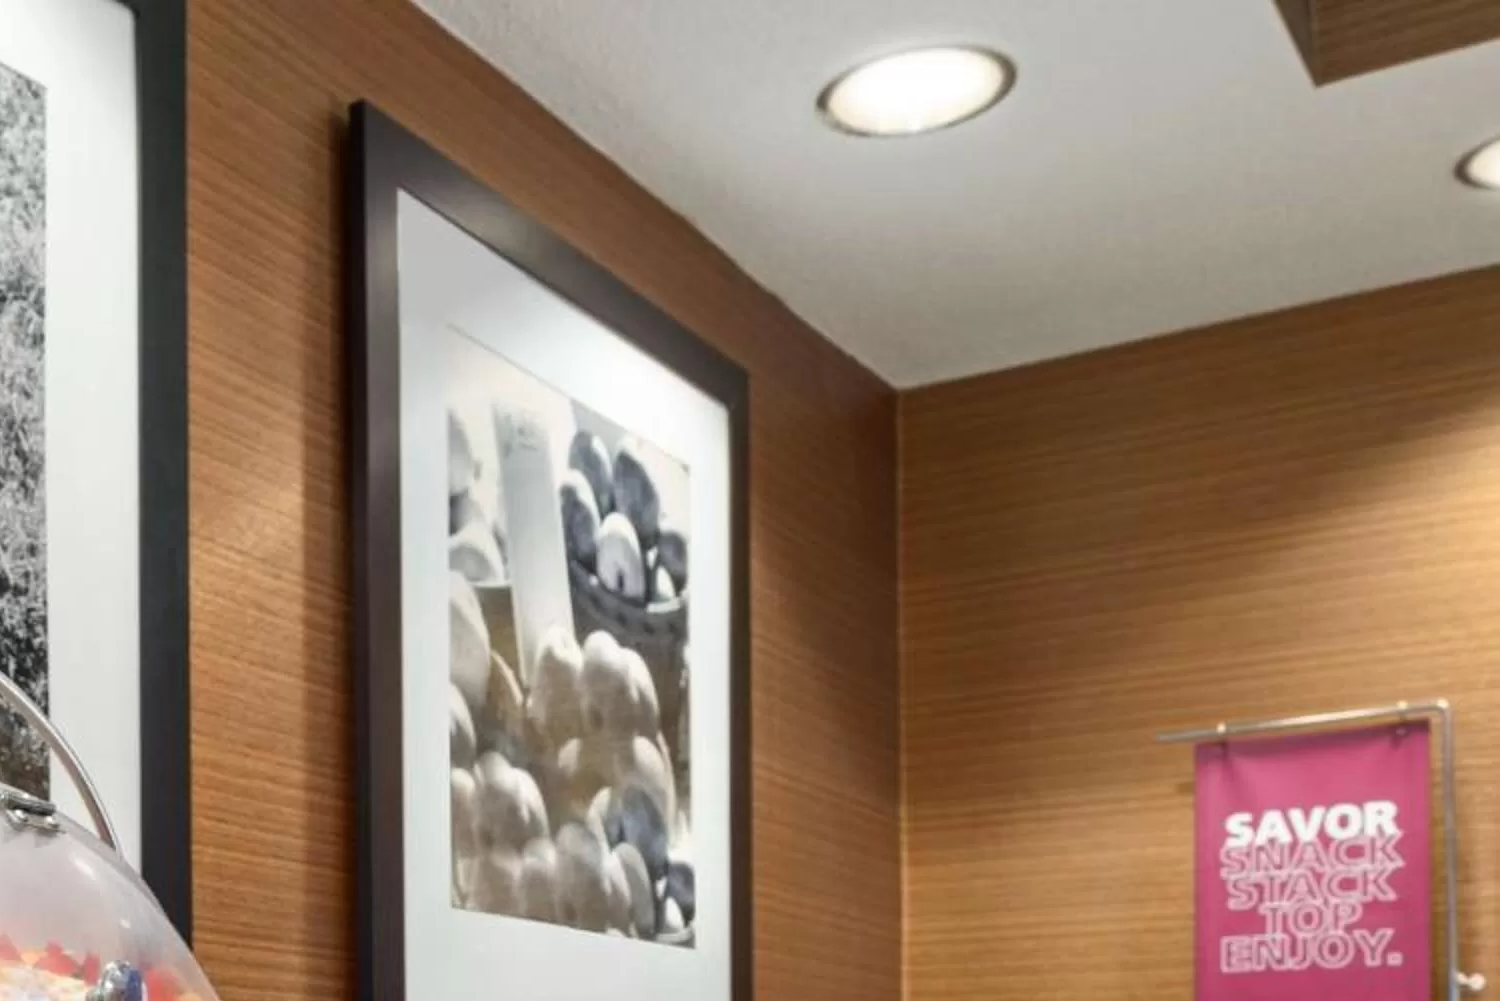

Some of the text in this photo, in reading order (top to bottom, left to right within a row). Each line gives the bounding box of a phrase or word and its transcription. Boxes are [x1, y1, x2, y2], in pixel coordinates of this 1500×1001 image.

[1224, 800, 1399, 847] SAVOR
[1219, 829, 1404, 879] SNACK
[1226, 863, 1397, 911] STACK
[1258, 900, 1363, 938] TOP
[1220, 928, 1404, 974] ENJOY.
